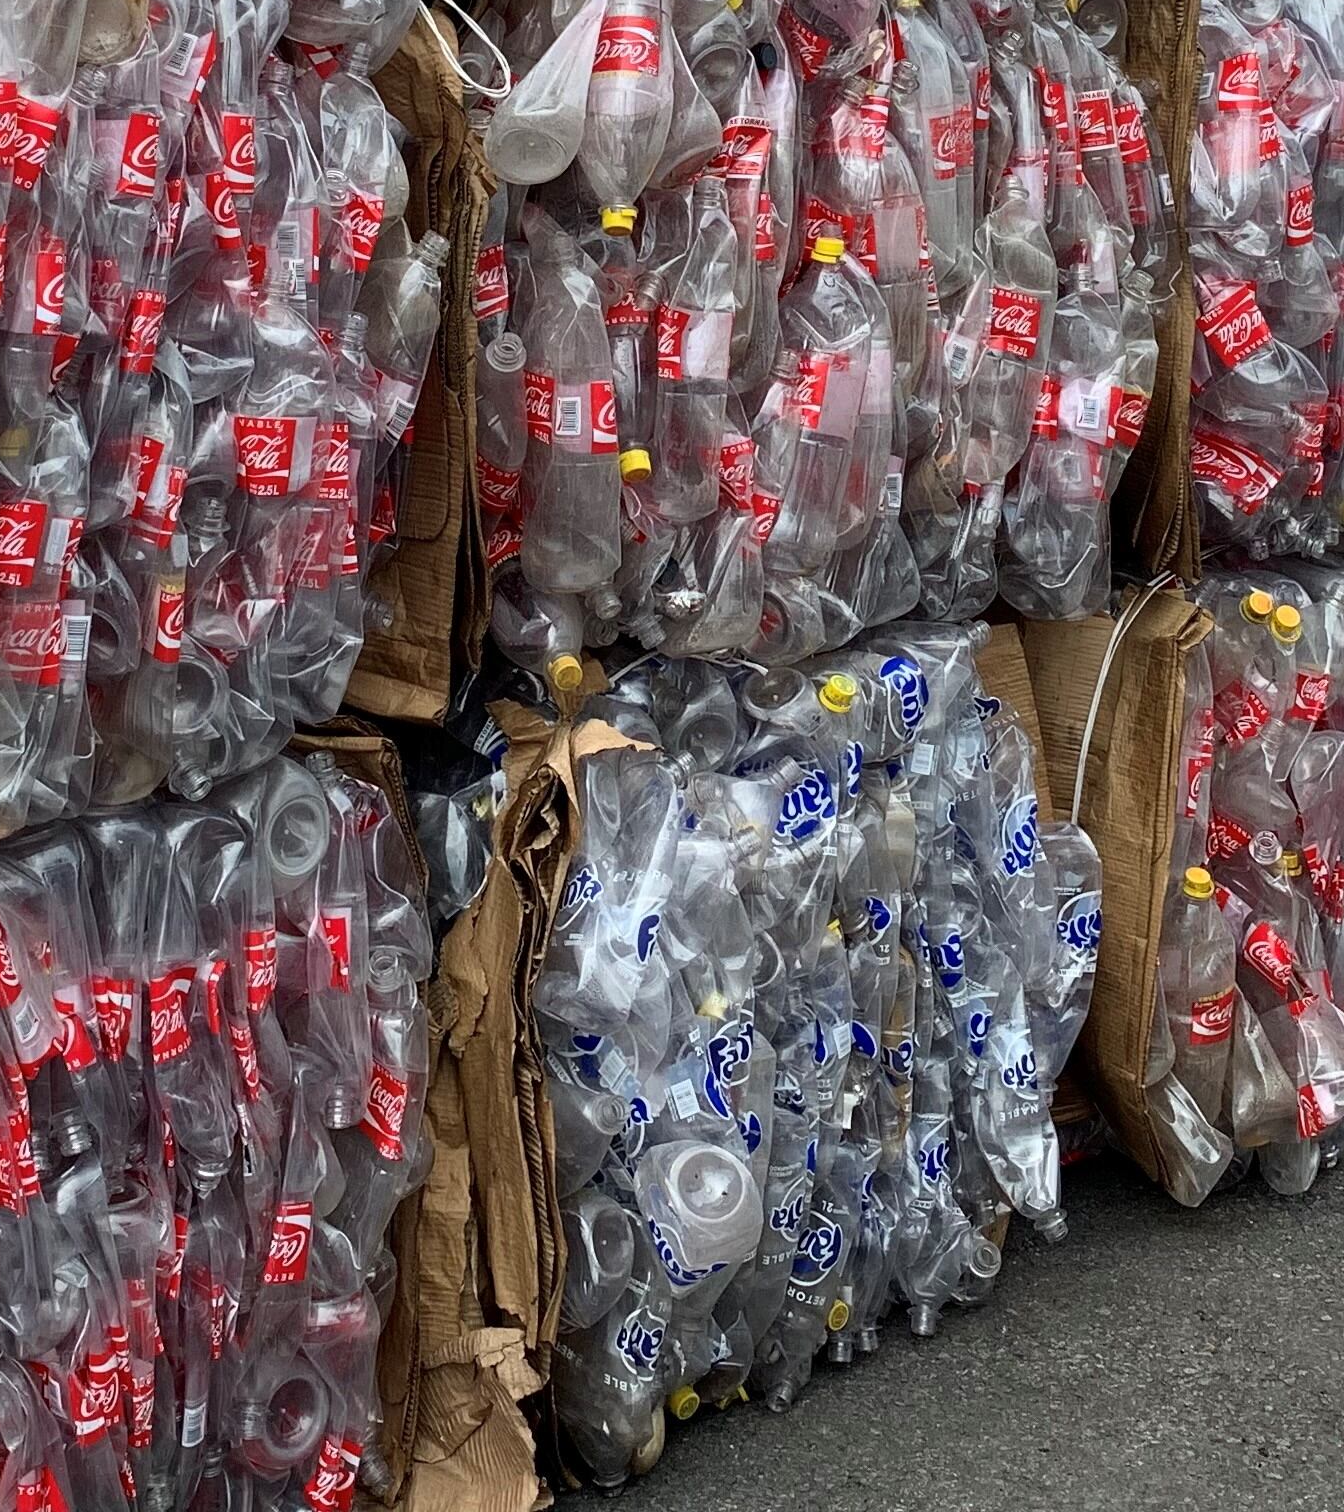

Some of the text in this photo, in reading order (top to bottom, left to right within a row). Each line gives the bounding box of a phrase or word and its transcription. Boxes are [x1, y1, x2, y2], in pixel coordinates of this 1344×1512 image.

[256, 484, 279, 496] 2.5L
[329, 486, 348, 499] 2.5L
[0, 573, 22, 585] 2.5L
[821, 1200, 833, 1212] 2L
